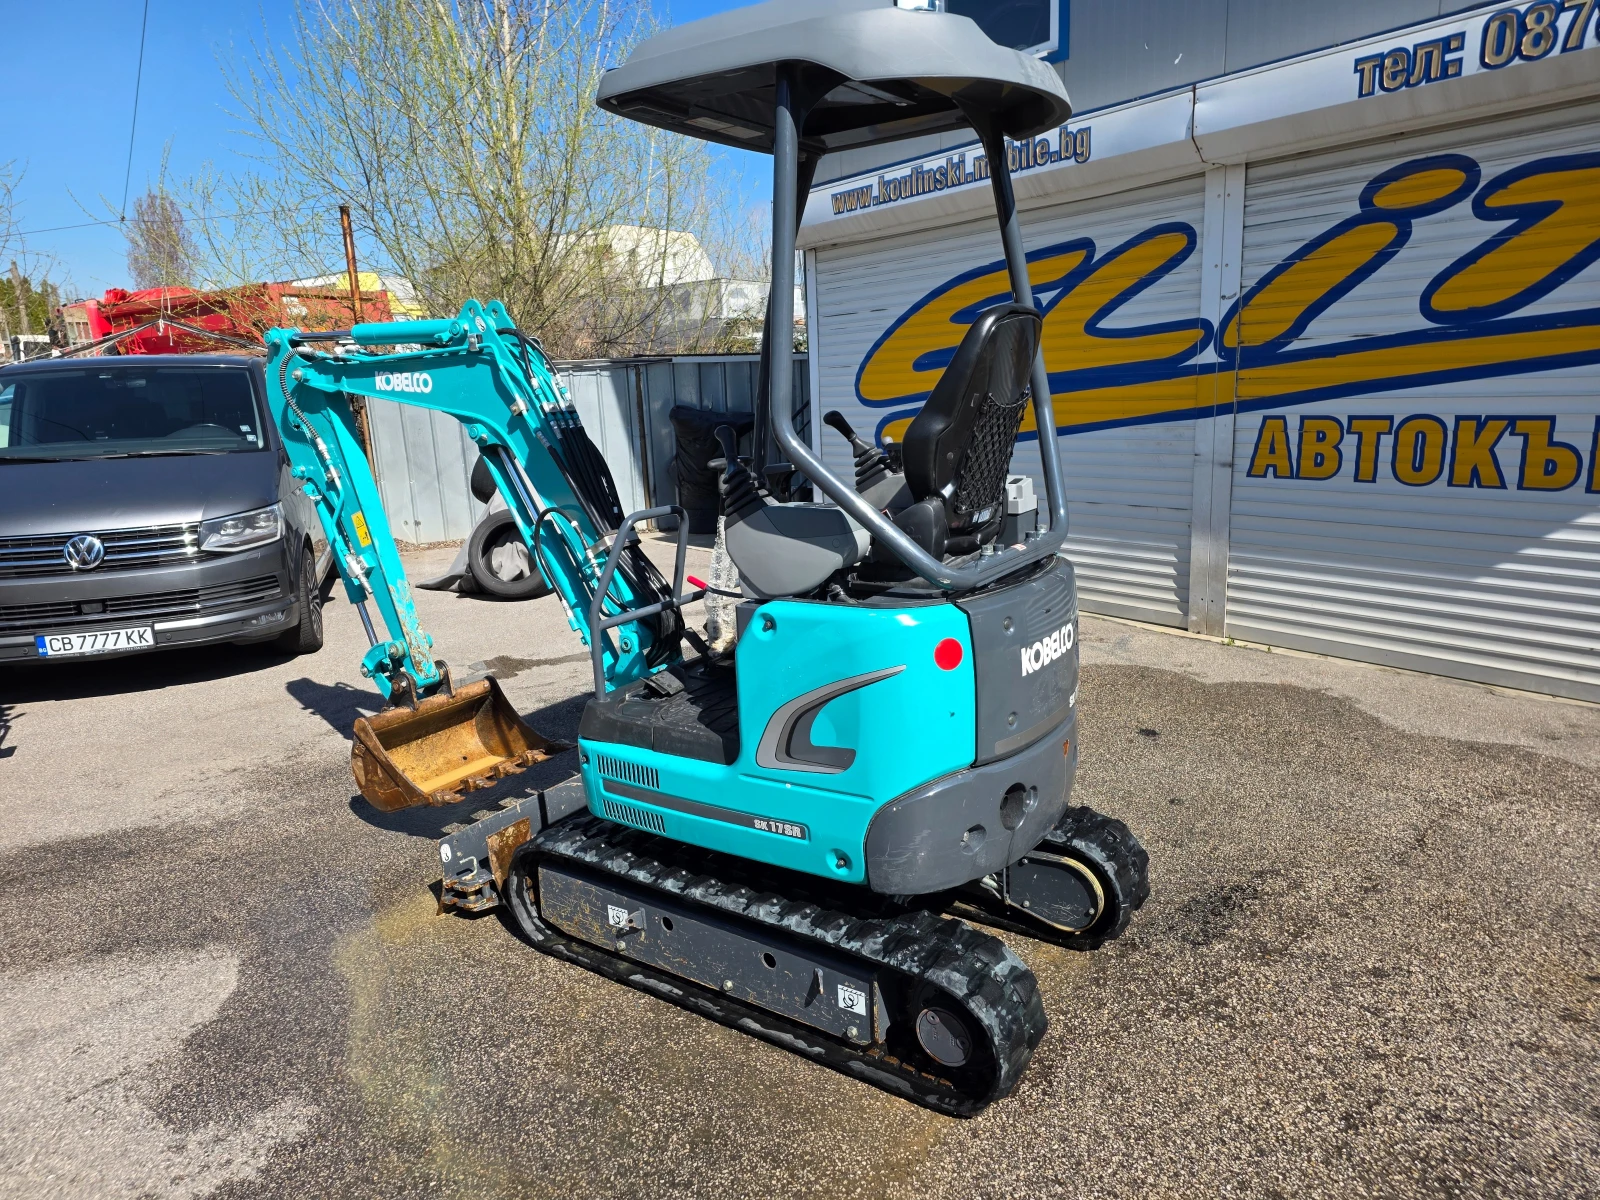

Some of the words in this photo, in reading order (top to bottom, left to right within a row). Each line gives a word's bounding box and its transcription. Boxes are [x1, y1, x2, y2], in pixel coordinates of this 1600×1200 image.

[1354, 31, 1466, 98] тел:
[1480, 0, 1600, 70] 087
[831, 125, 1092, 215] www.koulinski.mbile.bg
[375, 371, 433, 393] KOBELCO
[1246, 414, 1600, 494] АВТОКЪ
[49, 636, 74, 653] CB
[76, 631, 121, 651] 7777
[125, 628, 150, 646] KK
[1020, 622, 1074, 677] KOBELCO
